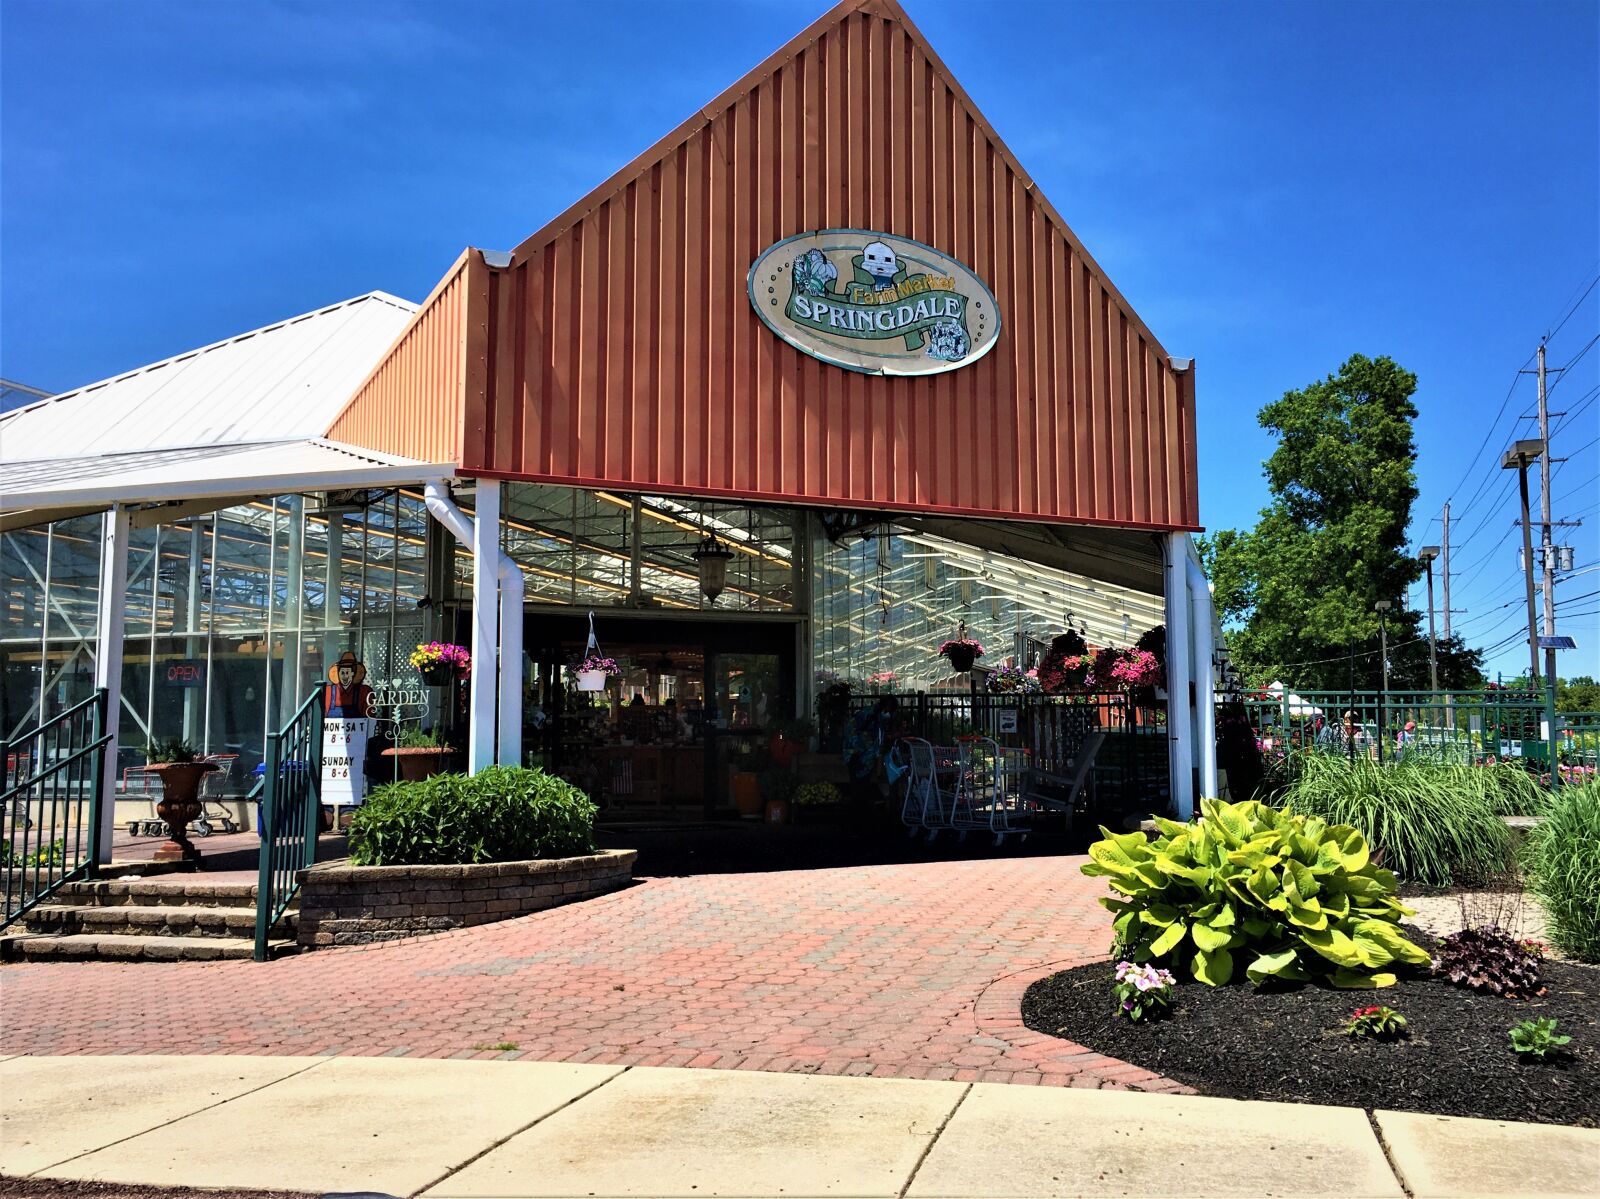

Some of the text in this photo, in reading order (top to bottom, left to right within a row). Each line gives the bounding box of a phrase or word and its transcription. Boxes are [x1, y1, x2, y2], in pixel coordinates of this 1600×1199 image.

[853, 273, 956, 304] Farm Market
[794, 295, 963, 332] SPRINGDALE
[167, 666, 201, 681] OPEN
[366, 690, 430, 706] GARDEN
[321, 756, 354, 766] SUNDAY
